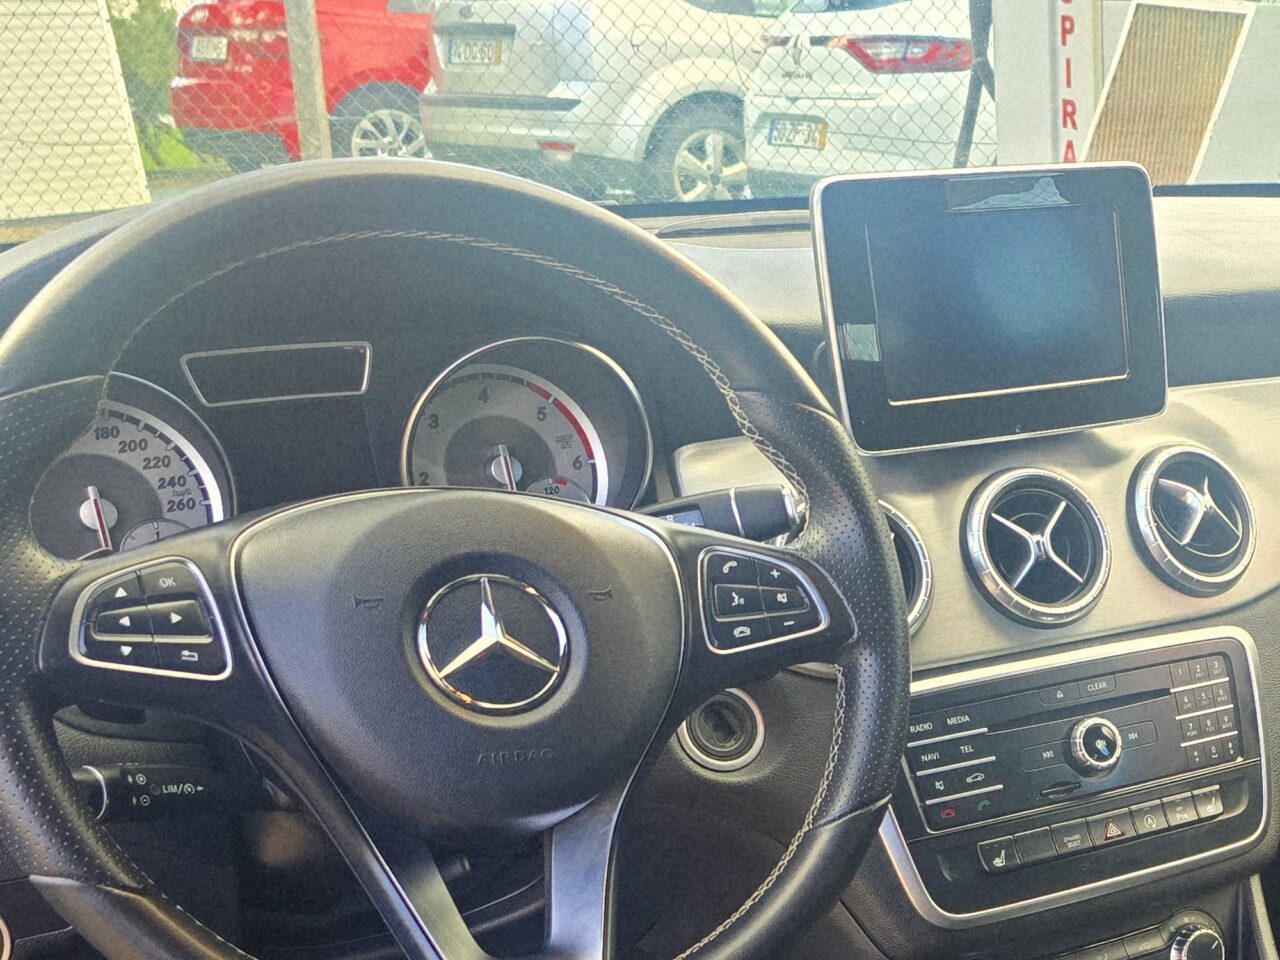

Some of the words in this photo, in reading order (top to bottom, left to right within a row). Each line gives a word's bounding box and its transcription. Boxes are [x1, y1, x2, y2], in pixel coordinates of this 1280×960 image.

[1060, 0, 1078, 163] PIRA
[478, 388, 489, 403] 4
[428, 414, 439, 429] 3
[536, 407, 547, 421] 5
[94, 425, 121, 441] 180
[118, 438, 149, 453] 200
[142, 455, 172, 470] 220
[572, 455, 583, 470] 6
[157, 475, 187, 489] 240
[418, 471, 429, 486] 2
[544, 485, 560, 495] 120
[167, 497, 196, 512] 260
[159, 577, 177, 588] OK
[1087, 681, 1107, 691] CLEAR
[909, 722, 933, 733] RADIO
[946, 715, 970, 725] MEDIA
[921, 752, 940, 762] NAVI
[960, 745, 975, 754] TEL
